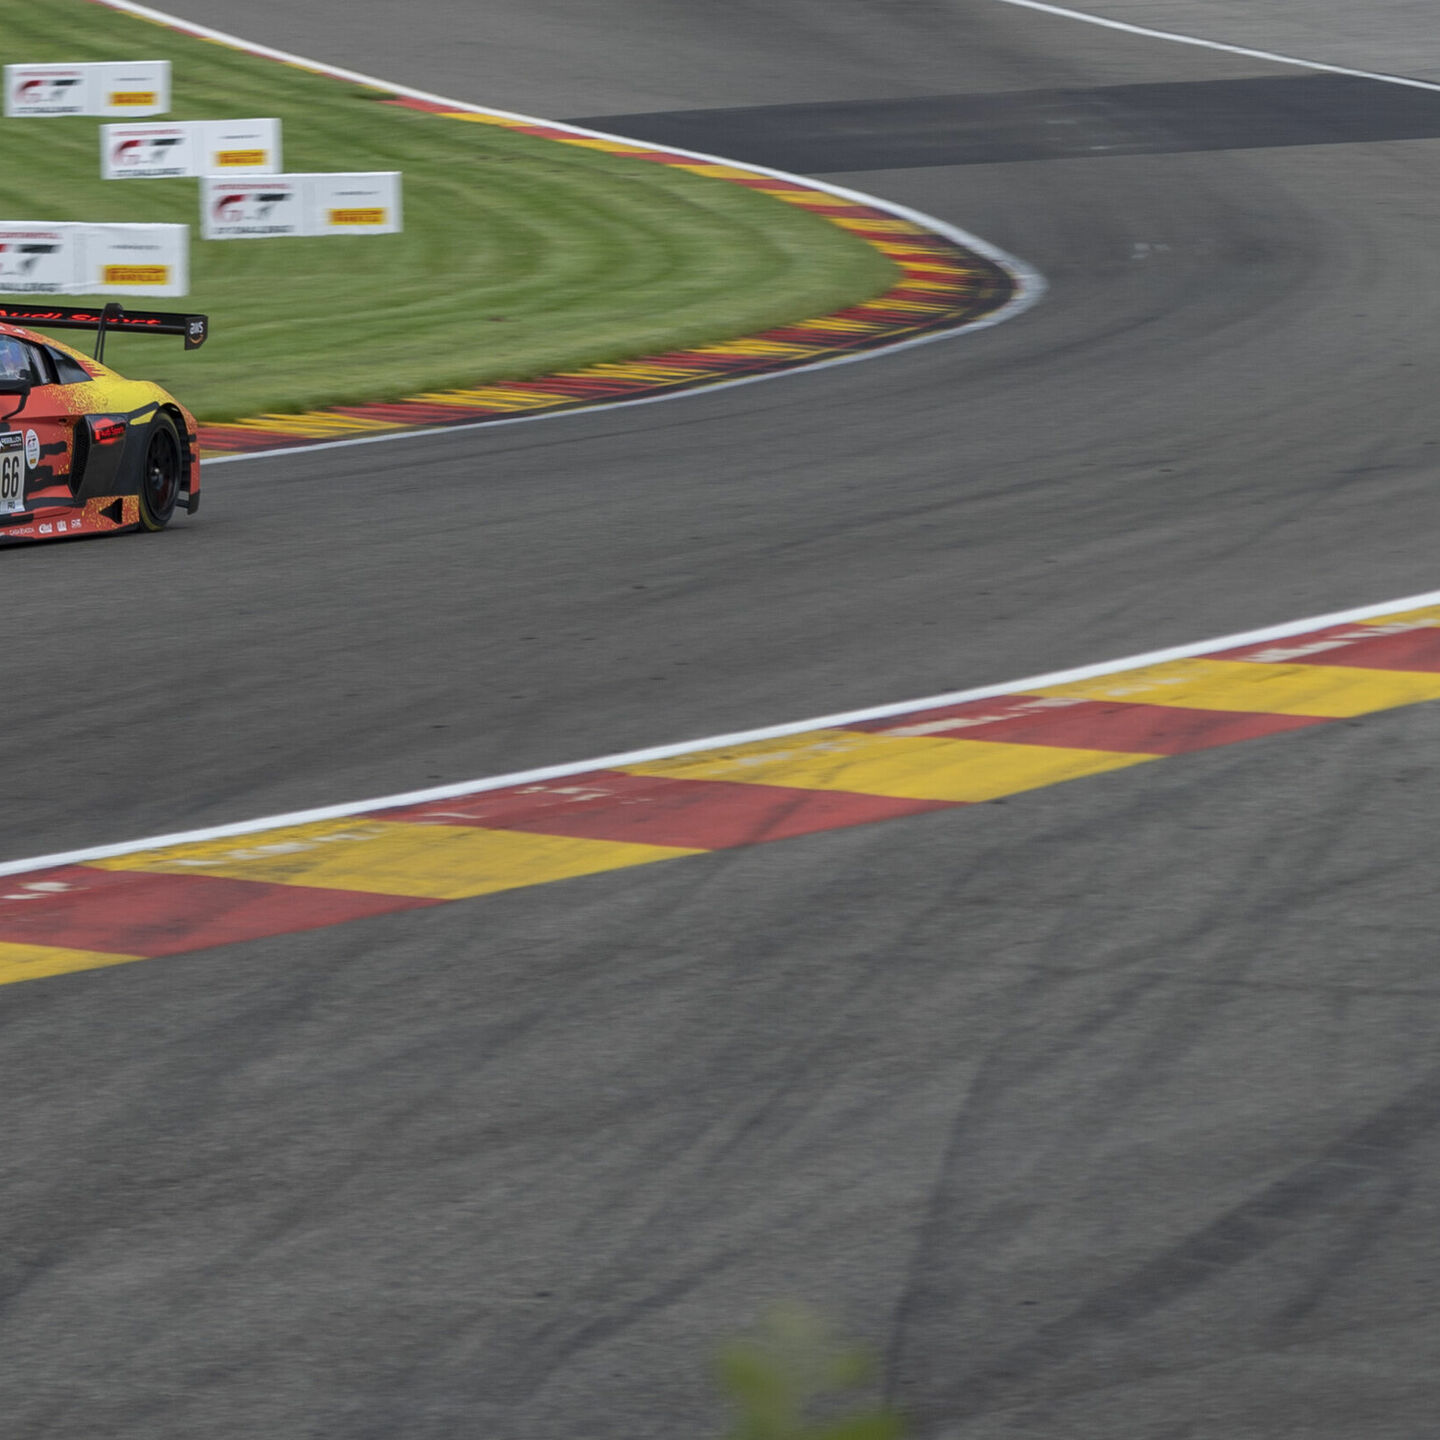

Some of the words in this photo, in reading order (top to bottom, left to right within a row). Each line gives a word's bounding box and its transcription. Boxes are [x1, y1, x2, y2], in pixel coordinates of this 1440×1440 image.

[68, 313, 162, 326] Sport
[189, 321, 203, 335] aws
[1, 456, 19, 499] 66
